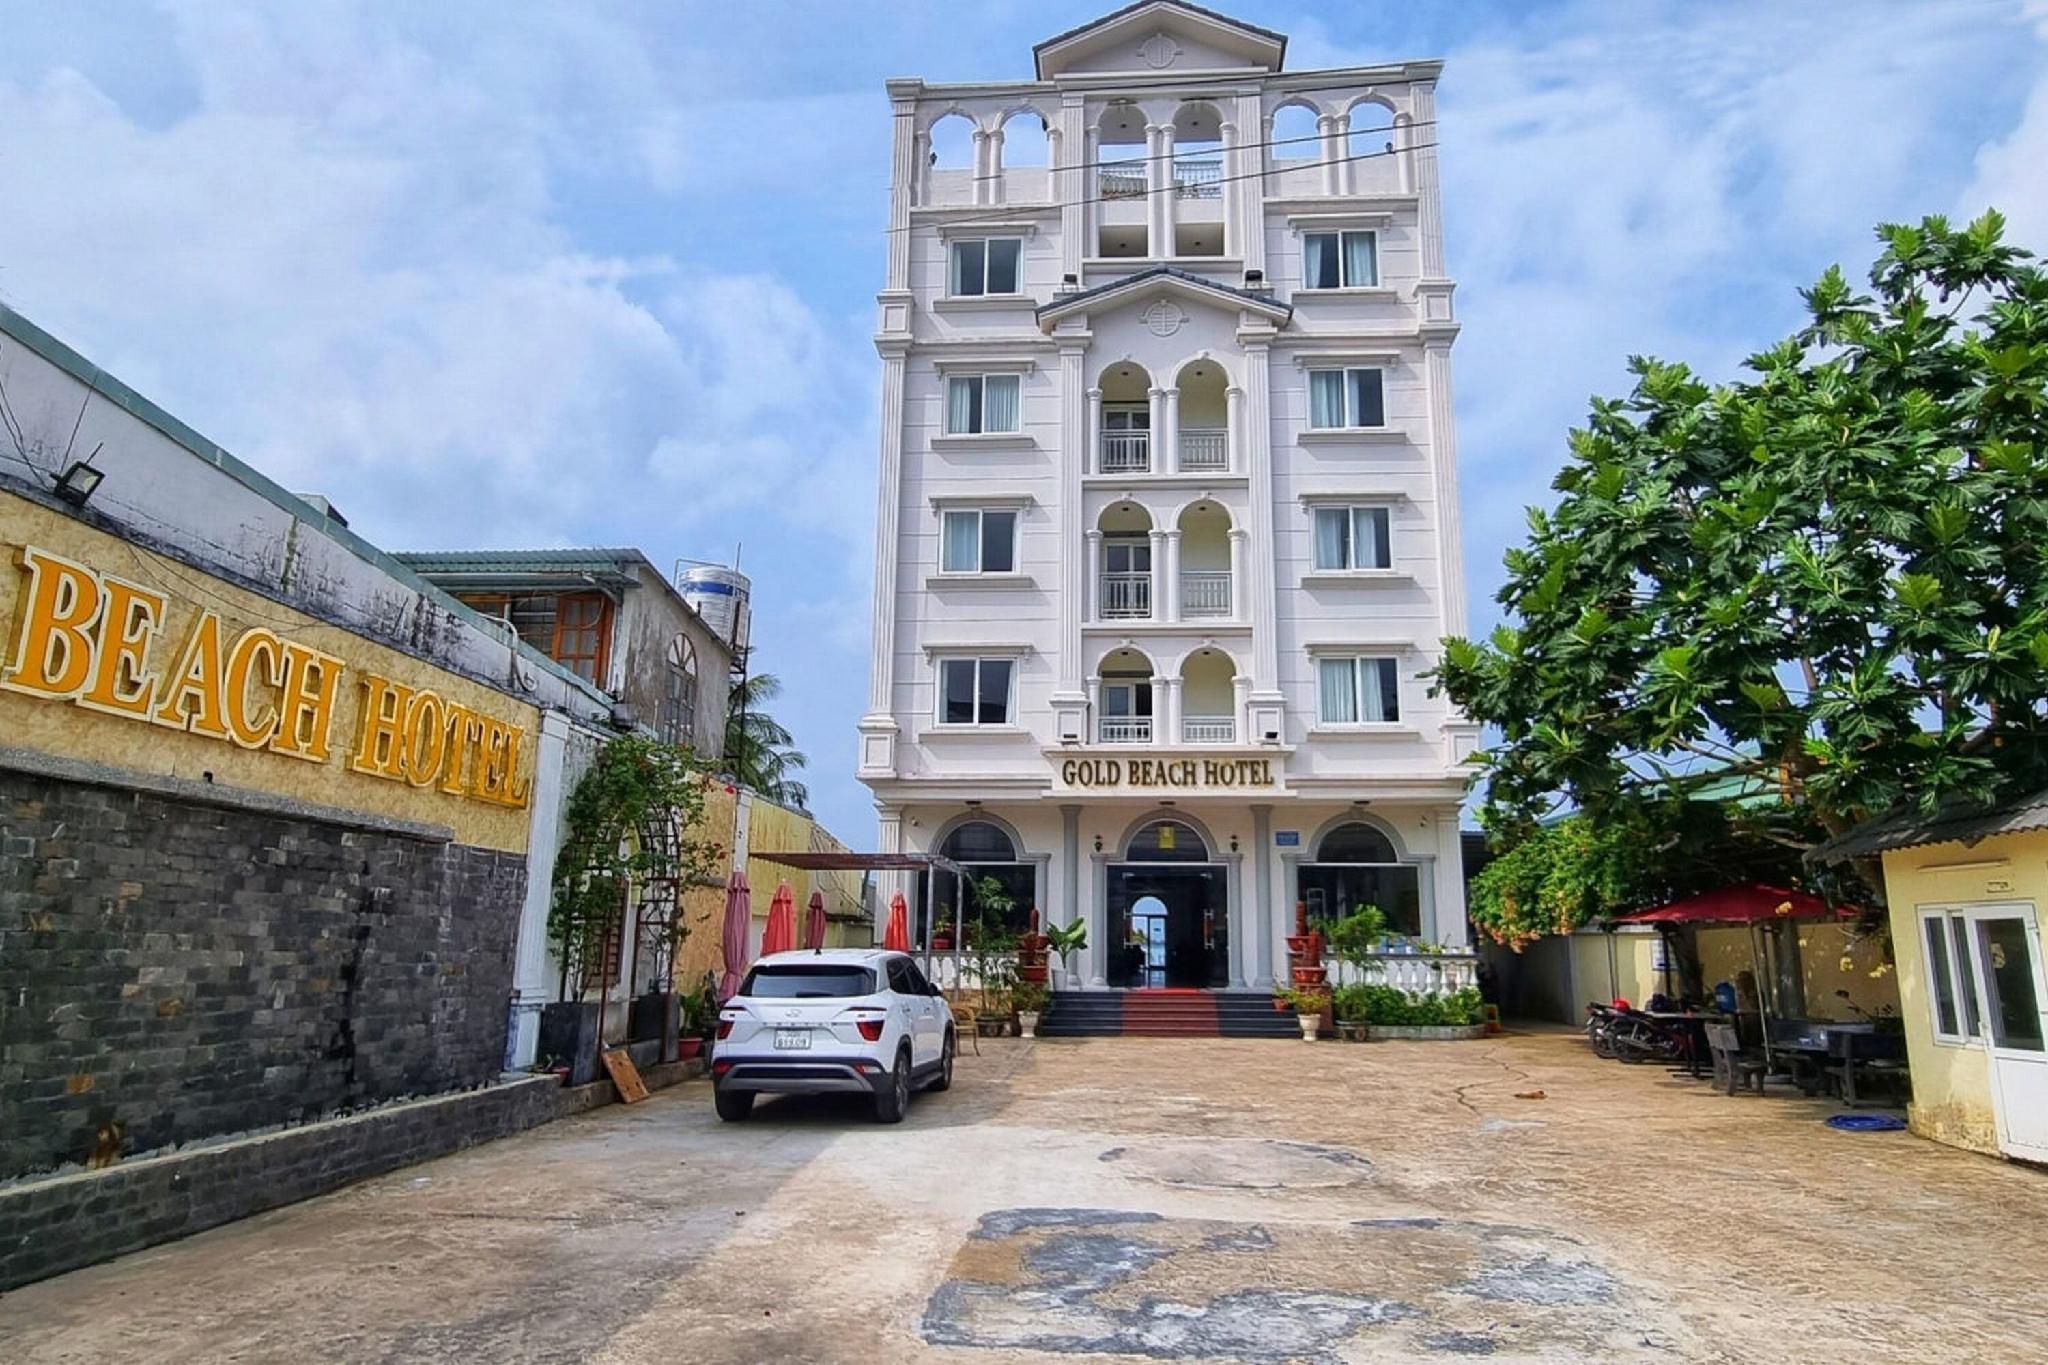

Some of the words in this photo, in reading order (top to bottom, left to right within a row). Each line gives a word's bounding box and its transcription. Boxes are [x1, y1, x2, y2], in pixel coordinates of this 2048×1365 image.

[0, 545, 345, 762] BEACH
[352, 673, 530, 809] HOTEL
[1062, 759, 1121, 786] GOLD
[1127, 759, 1197, 786] BEACH
[1203, 759, 1274, 786] HOTEL
